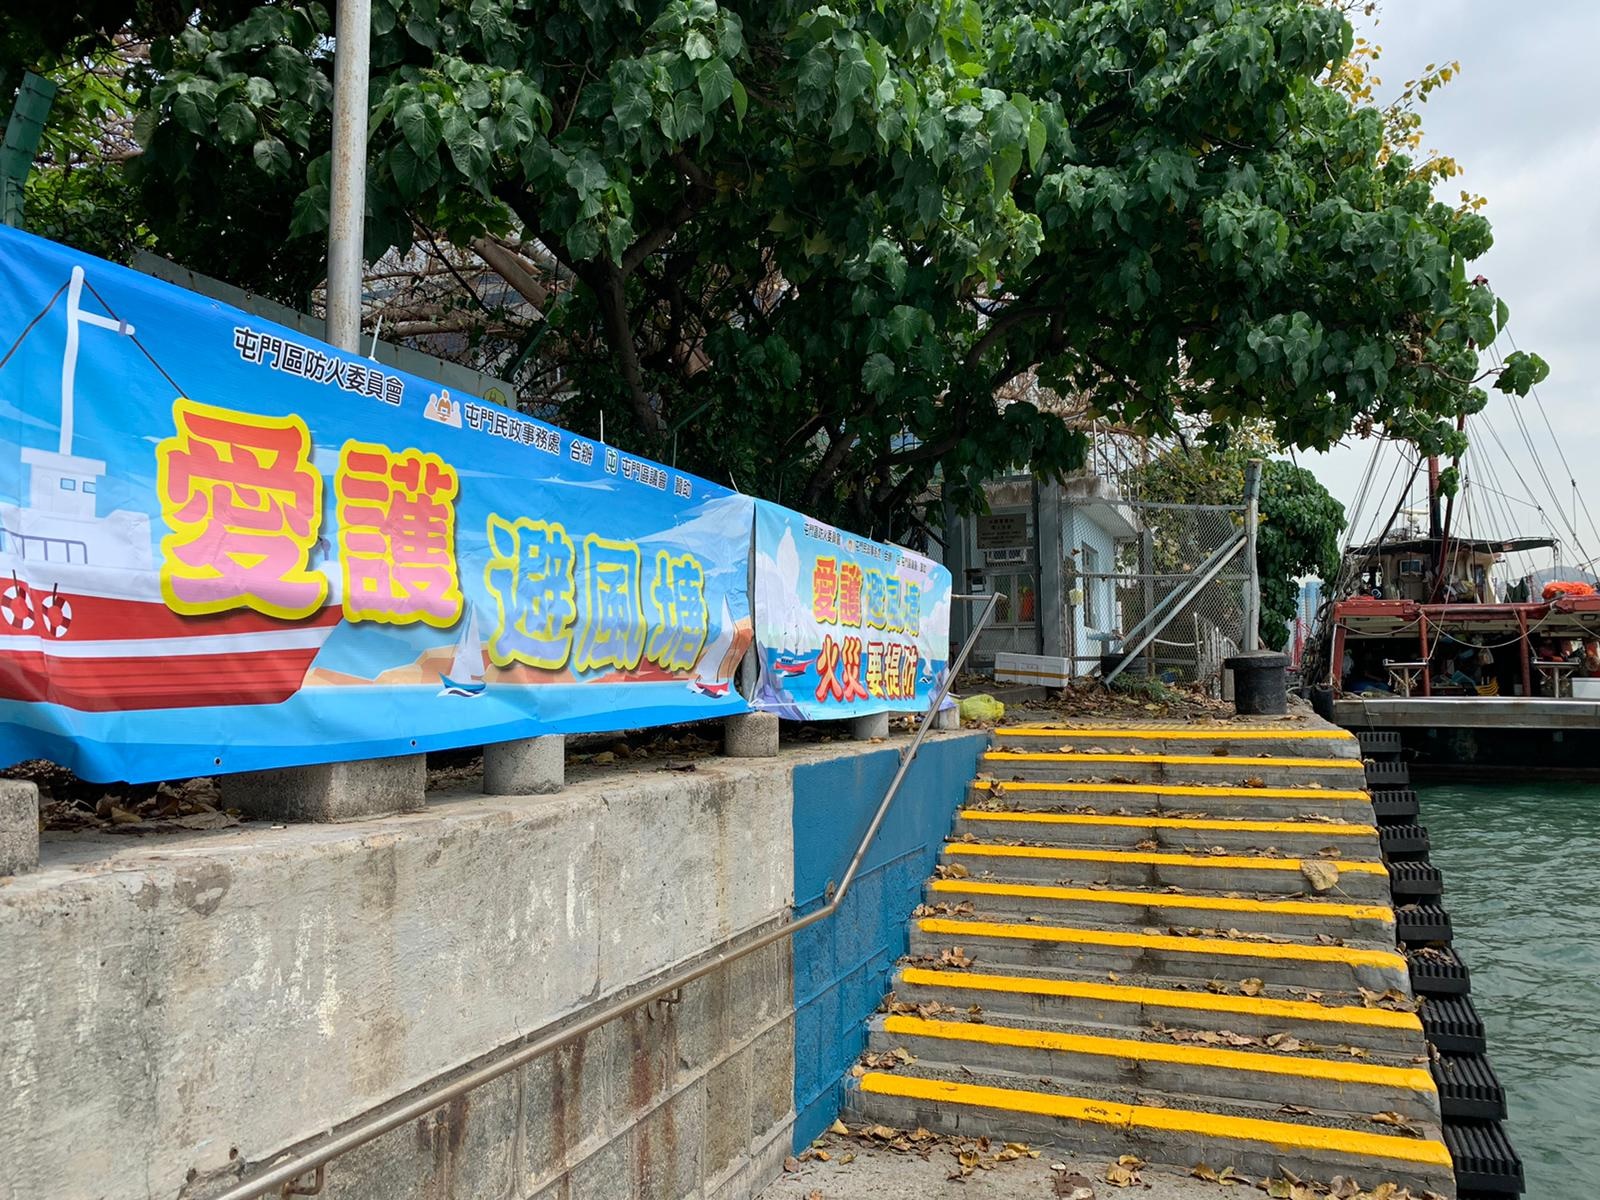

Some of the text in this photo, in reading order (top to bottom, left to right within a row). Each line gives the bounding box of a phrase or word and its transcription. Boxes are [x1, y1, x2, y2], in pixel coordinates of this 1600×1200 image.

[234, 327, 404, 406] 屯門區防火委員會
[465, 403, 560, 454] 屯門民政事務處
[569, 441, 594, 465] 合辦
[621, 457, 666, 489] 屯門區議會
[156, 399, 709, 673] 愛護 避風塘
[814, 556, 862, 628] 愛護
[815, 634, 918, 703] 火災 要提防
